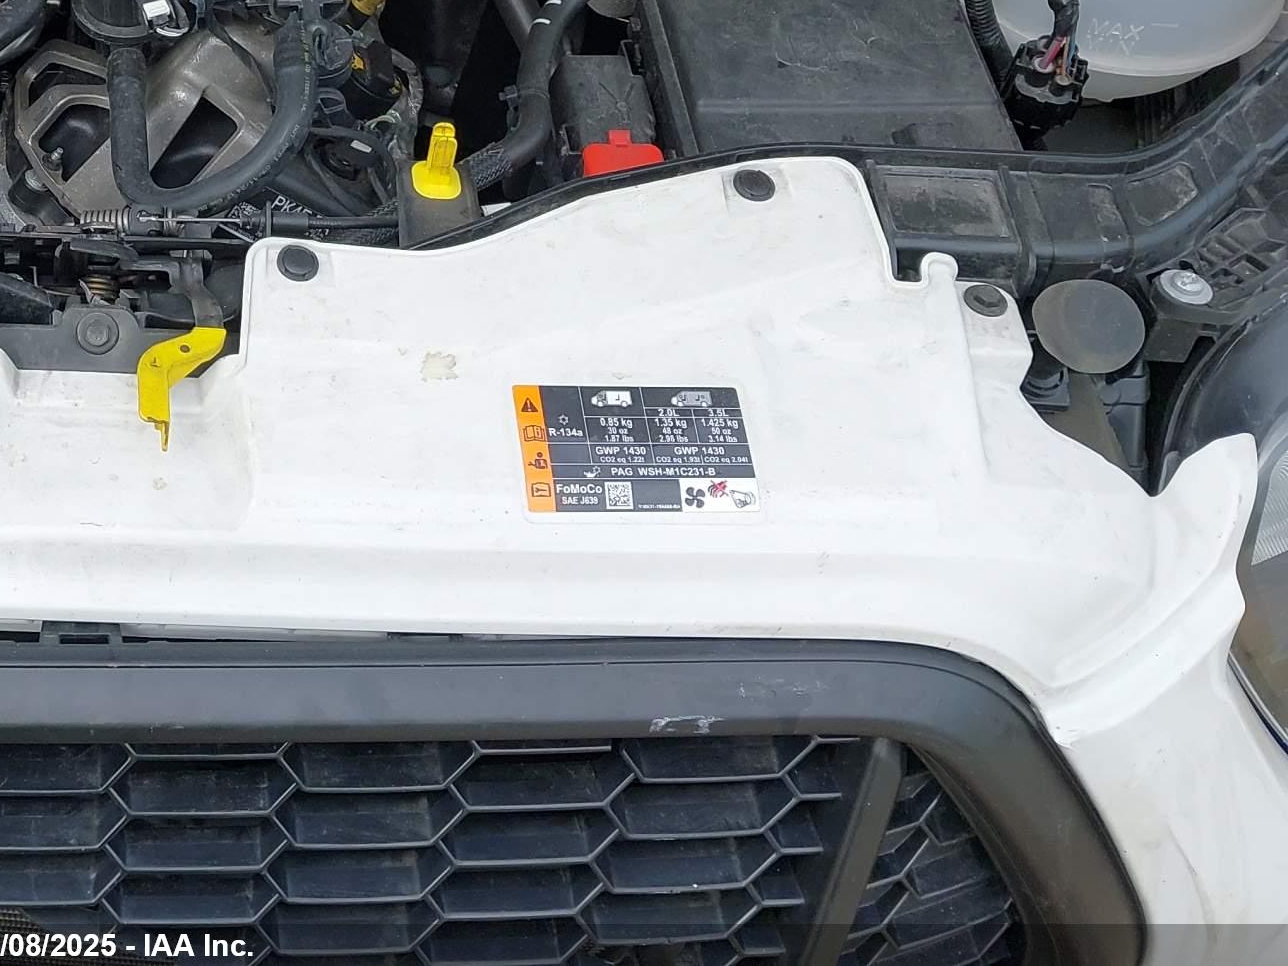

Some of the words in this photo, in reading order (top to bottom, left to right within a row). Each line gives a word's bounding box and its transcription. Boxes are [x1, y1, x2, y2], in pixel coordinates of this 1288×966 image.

[658, 409, 680, 417] 2.0L
[708, 409, 729, 417] 3.5L
[599, 417, 619, 427] 0.85
[621, 418, 633, 428] kg
[654, 418, 674, 427] 1.35
[675, 419, 687, 428] kg
[701, 419, 725, 427] 1.425
[726, 419, 739, 429] kg
[548, 427, 584, 437] R-134a
[595, 446, 620, 455] GWP
[622, 446, 647, 455] 1430
[674, 446, 699, 455] GWP
[701, 446, 725, 455] 1430
[611, 467, 633, 476] PAG
[637, 467, 716, 476] WSH-M1C231-B
[556, 484, 603, 494] FoMoCo
[561, 496, 579, 505] SAE
[580, 496, 599, 505] J639
